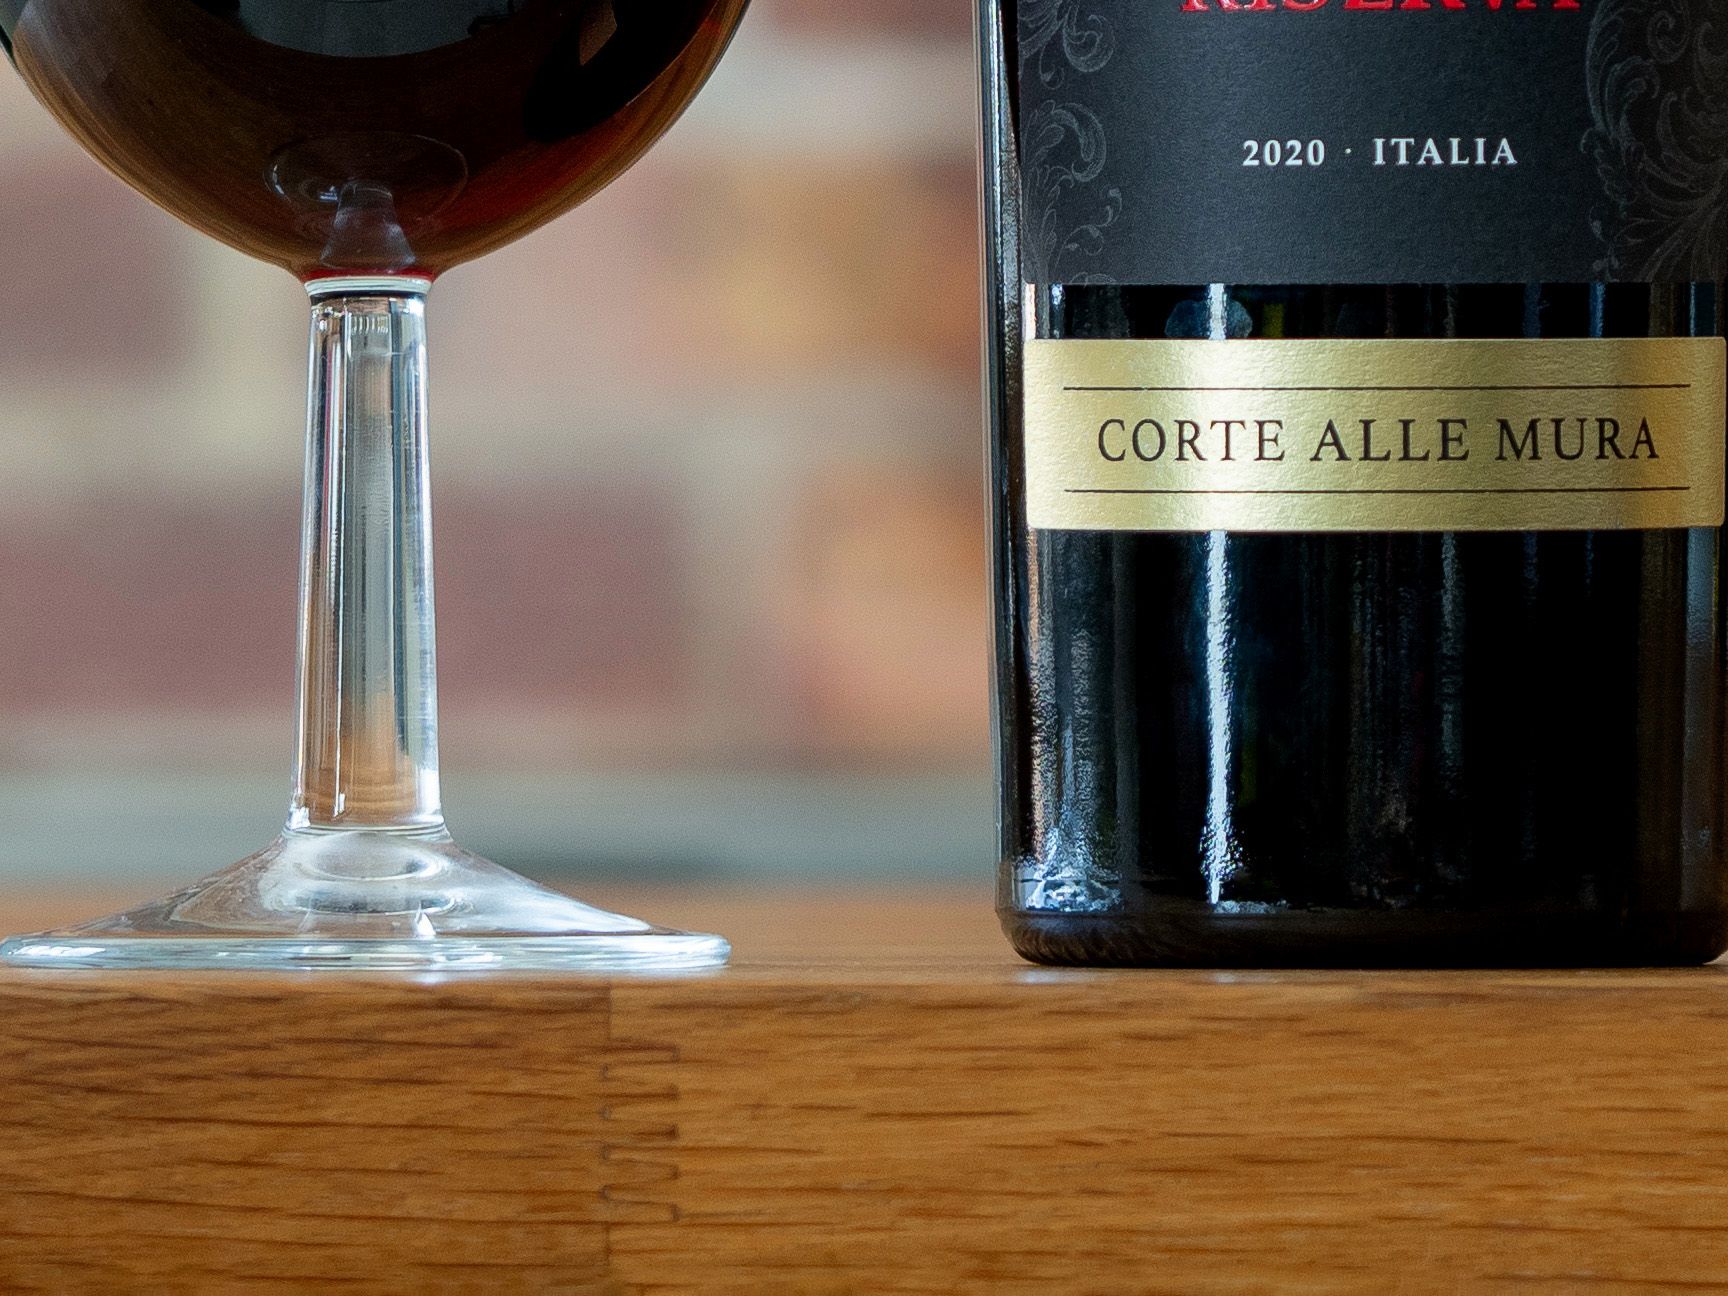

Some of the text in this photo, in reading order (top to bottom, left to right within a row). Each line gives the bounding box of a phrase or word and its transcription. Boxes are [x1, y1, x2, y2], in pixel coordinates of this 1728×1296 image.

[1242, 137, 1518, 167] 2020 ITALIA
[1097, 417, 1661, 463] CORTE ALLE MURA
